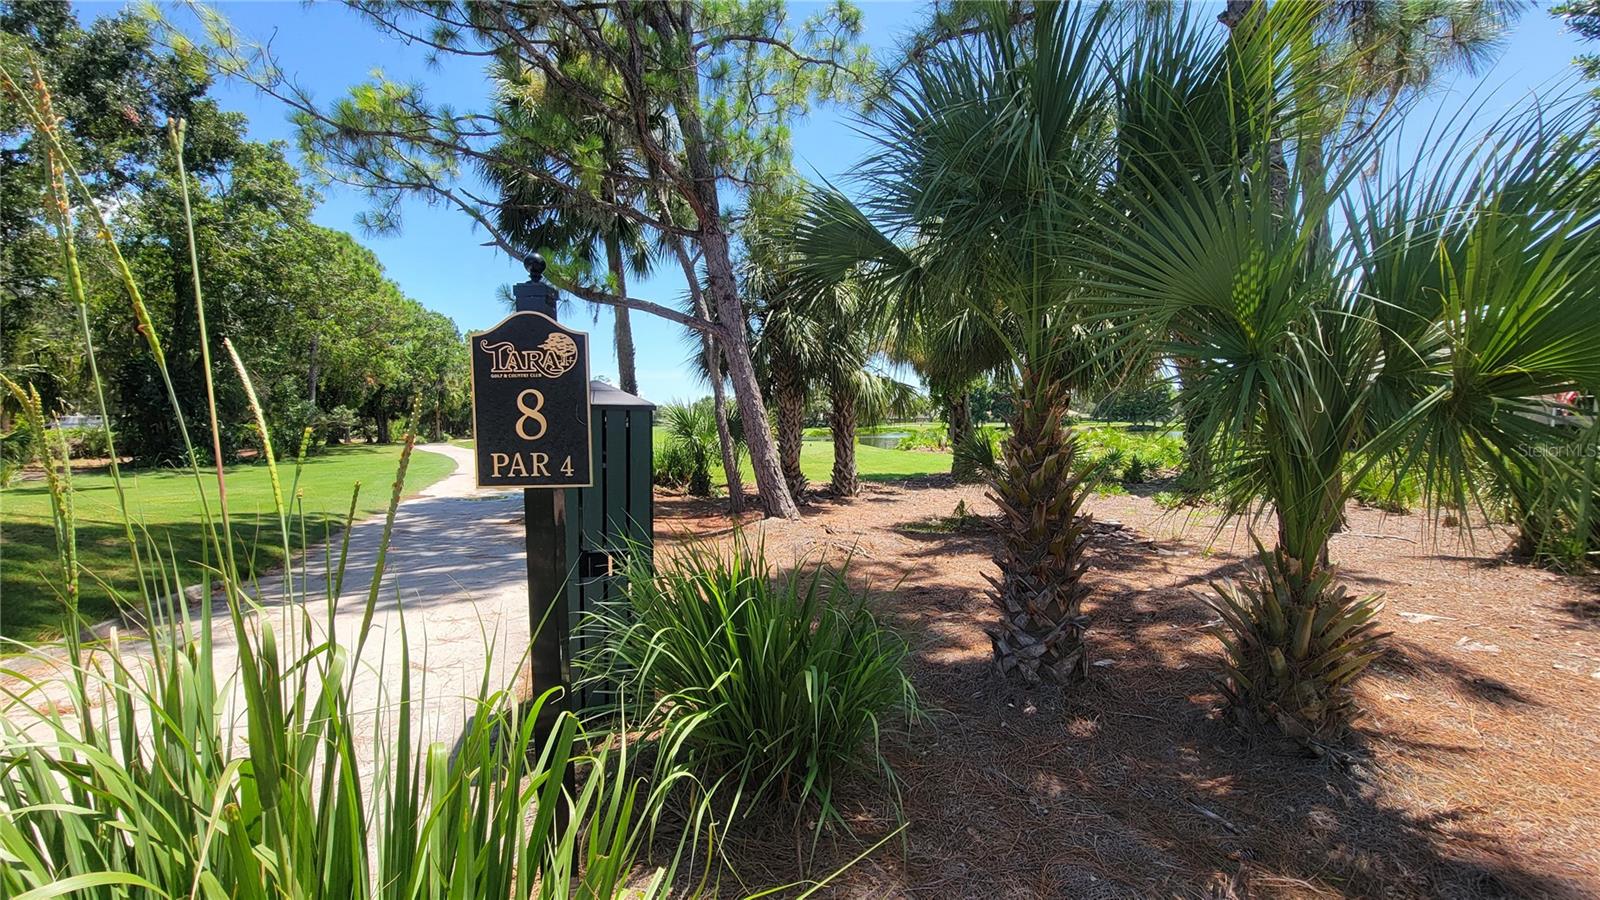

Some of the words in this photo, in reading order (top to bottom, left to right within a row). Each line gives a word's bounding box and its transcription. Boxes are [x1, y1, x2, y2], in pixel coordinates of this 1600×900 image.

[480, 339, 564, 377] TARA
[515, 388, 548, 441] 8
[490, 452, 551, 478] PAR
[560, 455, 575, 477] 4
